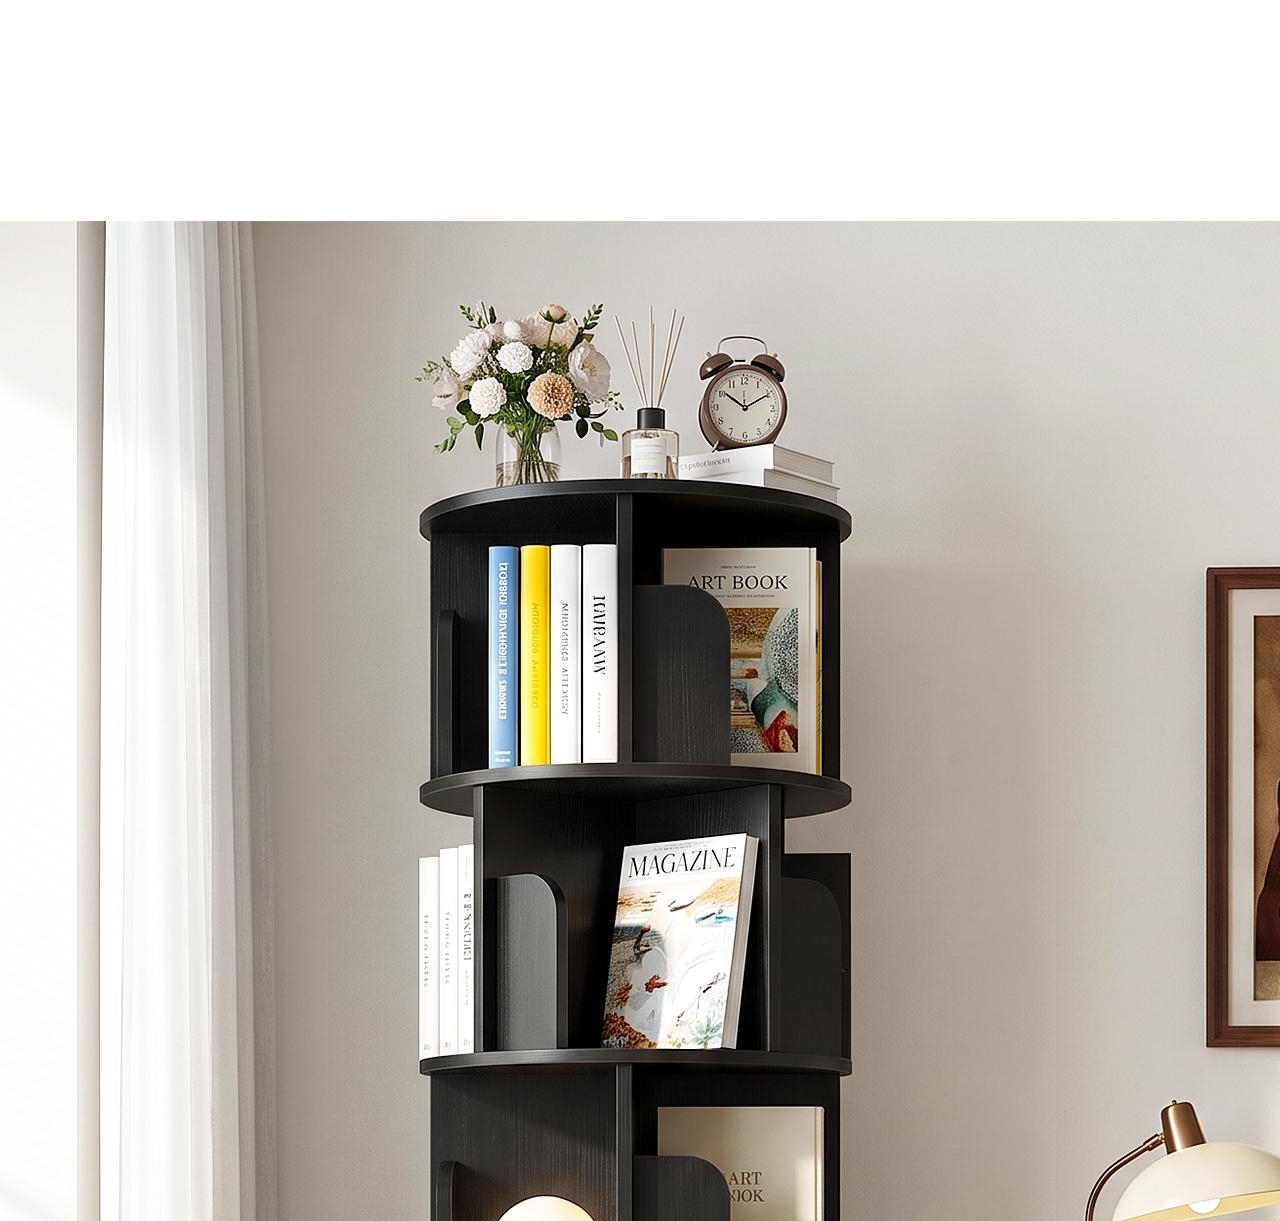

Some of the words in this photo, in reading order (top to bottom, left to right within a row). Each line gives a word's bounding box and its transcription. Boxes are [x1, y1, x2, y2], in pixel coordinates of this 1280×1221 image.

[728, 380, 736, 389] 11
[740, 377, 749, 386] 12
[769, 405, 776, 413] 3
[728, 428, 734, 436] 7
[756, 428, 762, 436] 5
[688, 575, 727, 590] ART
[732, 575, 788, 590] BOOK
[628, 846, 737, 879] MAGAZINE
[729, 1171, 762, 1186] ART
